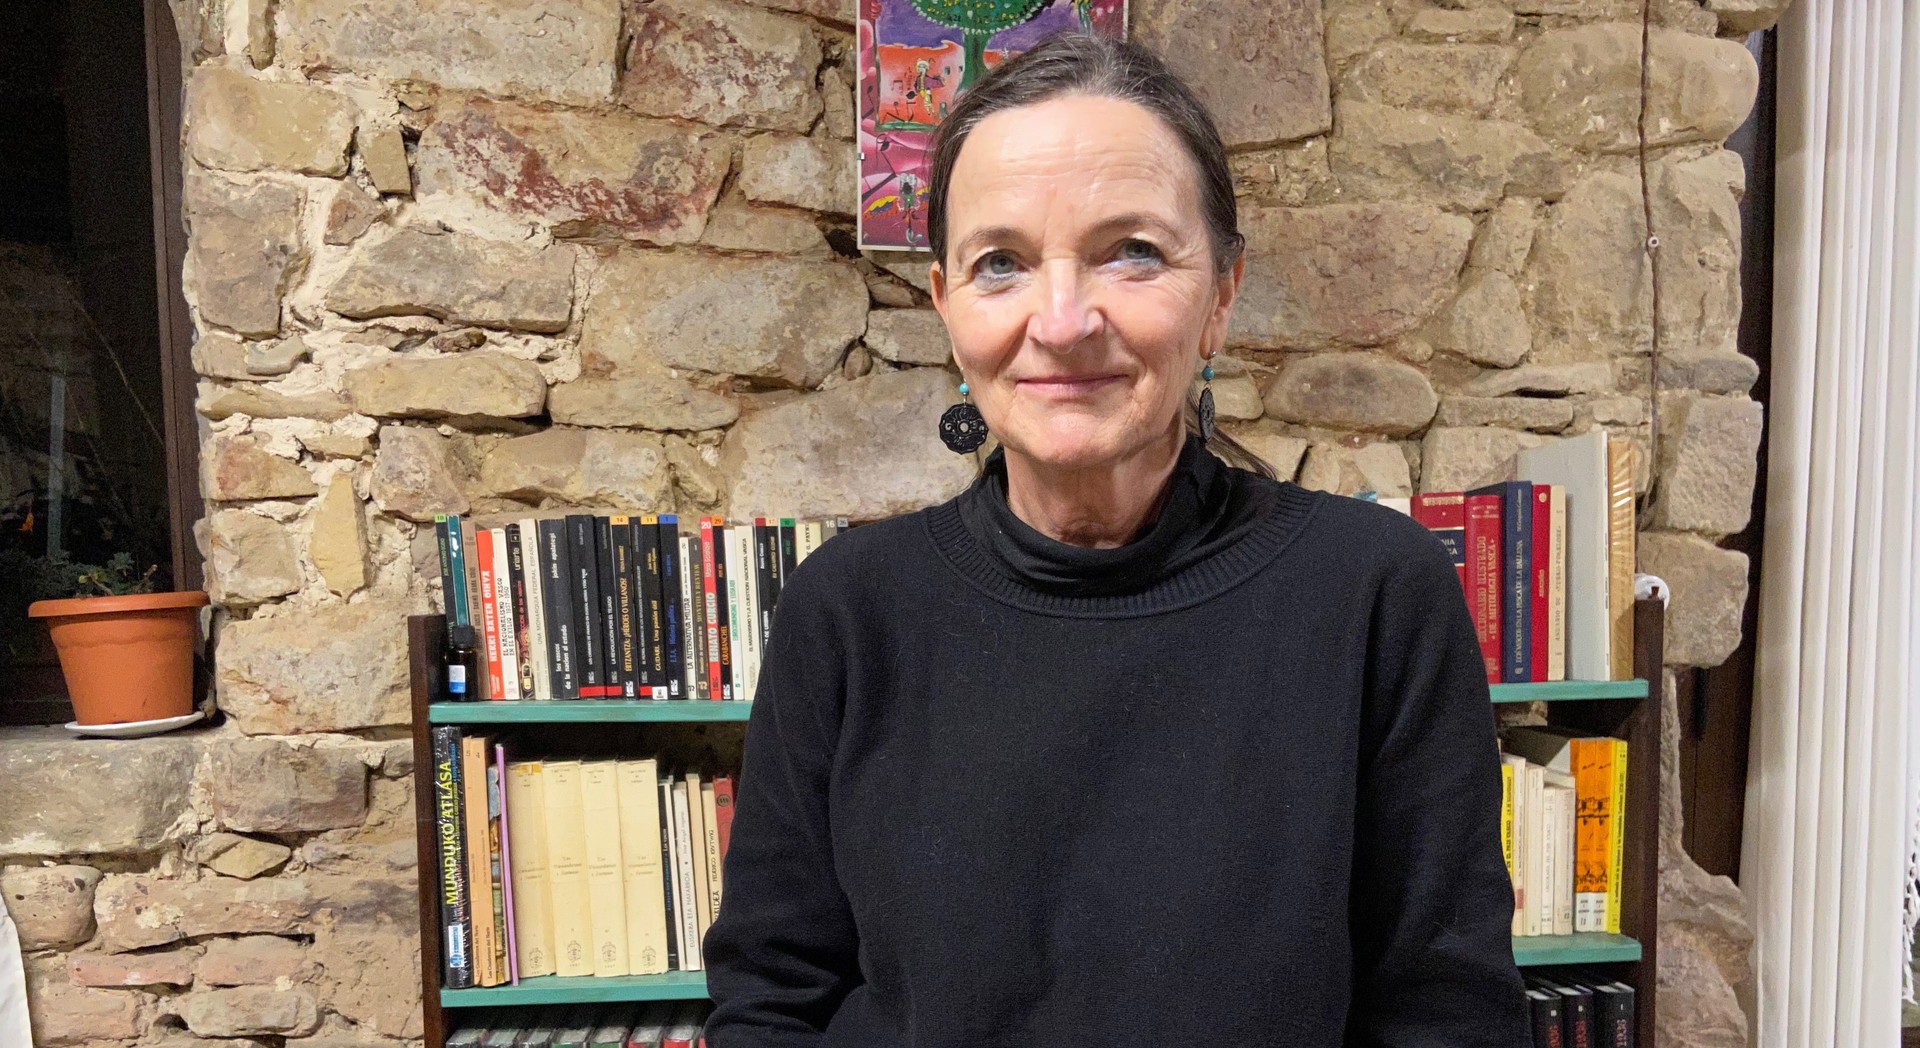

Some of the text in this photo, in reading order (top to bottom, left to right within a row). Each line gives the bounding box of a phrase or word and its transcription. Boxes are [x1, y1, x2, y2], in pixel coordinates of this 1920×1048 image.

[701, 521, 712, 530] 20
[825, 520, 836, 529] 16
[512, 547, 521, 571] uriarte
[549, 532, 559, 579] jokin apalategi
[693, 563, 701, 590] REVIEW
[1476, 535, 1487, 642] DICCIONARIO ILUSTRADO
[1488, 544, 1496, 634] DE MITOLOGIA VASCA
[485, 603, 495, 632] BATEN
[496, 578, 509, 656] EL NACIONALISMO VASCO
[652, 611, 660, 629] pasión
[706, 592, 719, 662] RENATO CURCIO
[685, 621, 693, 660] ALTERNATIVA
[611, 657, 617, 665] LA
[687, 661, 694, 670] LA
[565, 681, 571, 690] de
[441, 822, 458, 905] MUNDUKO
